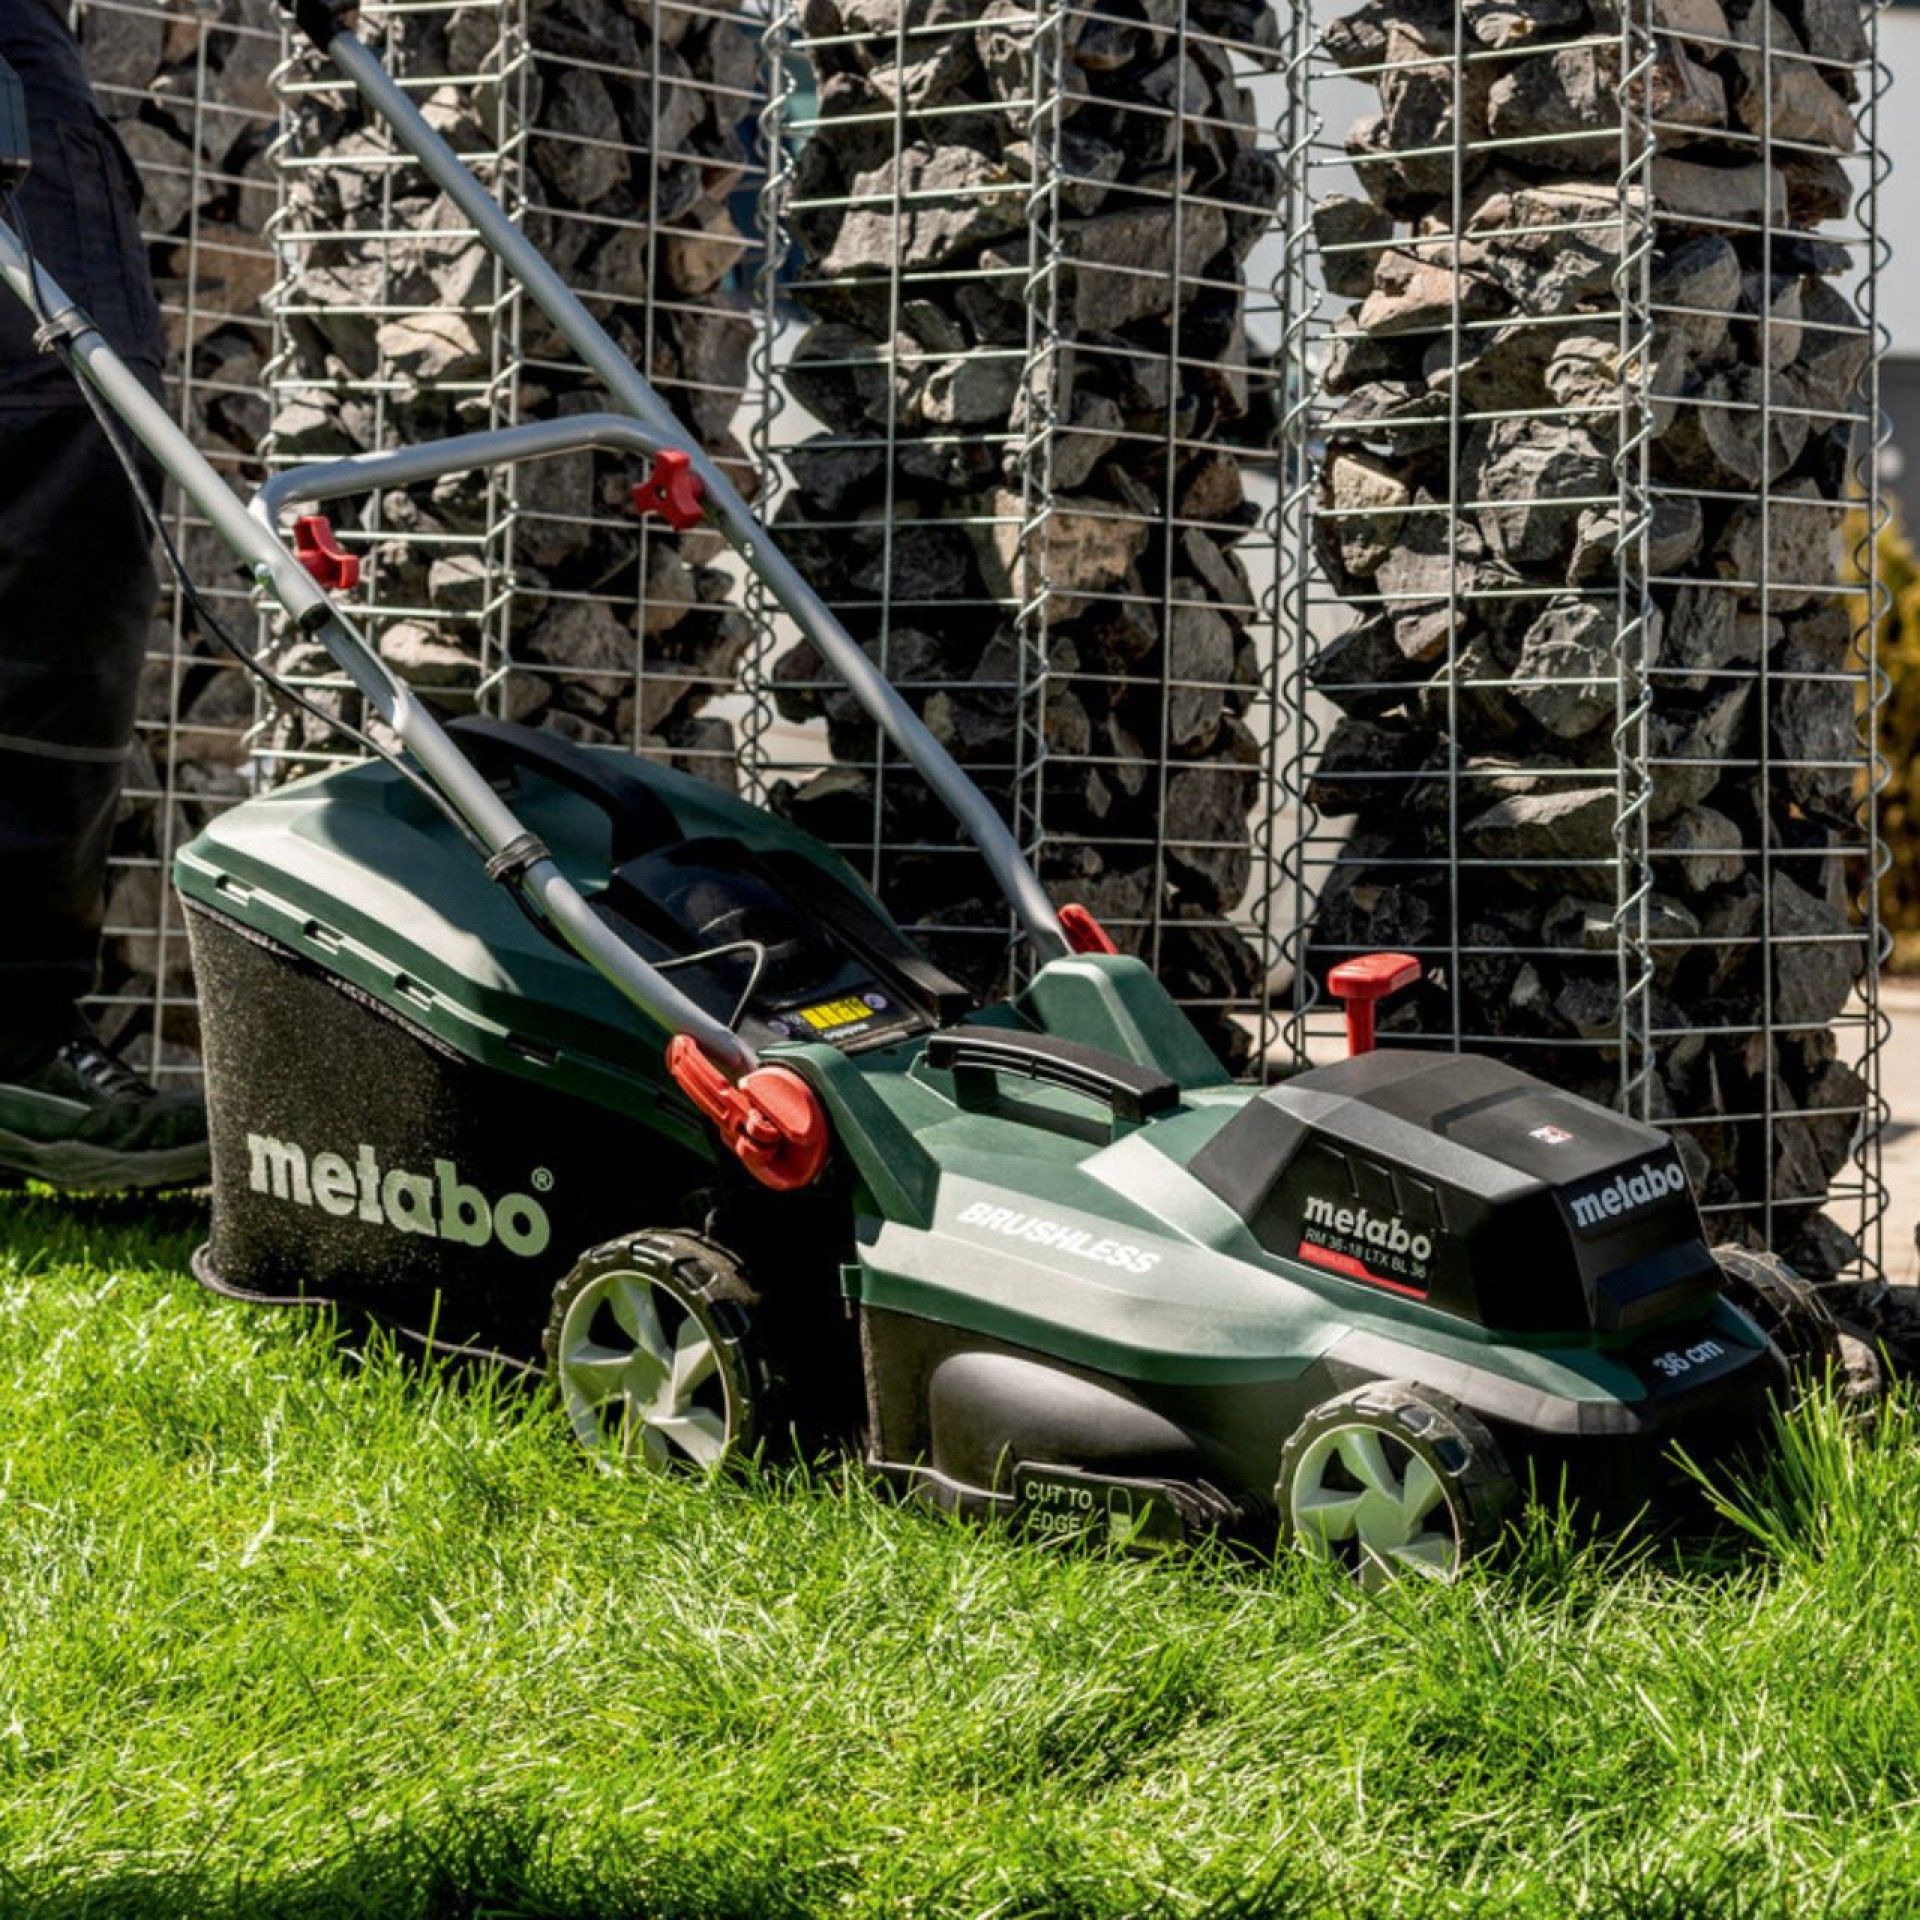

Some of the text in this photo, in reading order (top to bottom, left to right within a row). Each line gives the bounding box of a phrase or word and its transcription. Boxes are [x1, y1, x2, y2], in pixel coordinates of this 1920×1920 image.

[1570, 1163, 1684, 1228] metabo
[956, 1202, 1161, 1273] BRUSHLESS
[1304, 1196, 1431, 1260] metabo
[1653, 1340, 1725, 1378] 36 cm
[1025, 1481, 1093, 1510] CUT TO
[1029, 1509, 1081, 1534] EDGE
